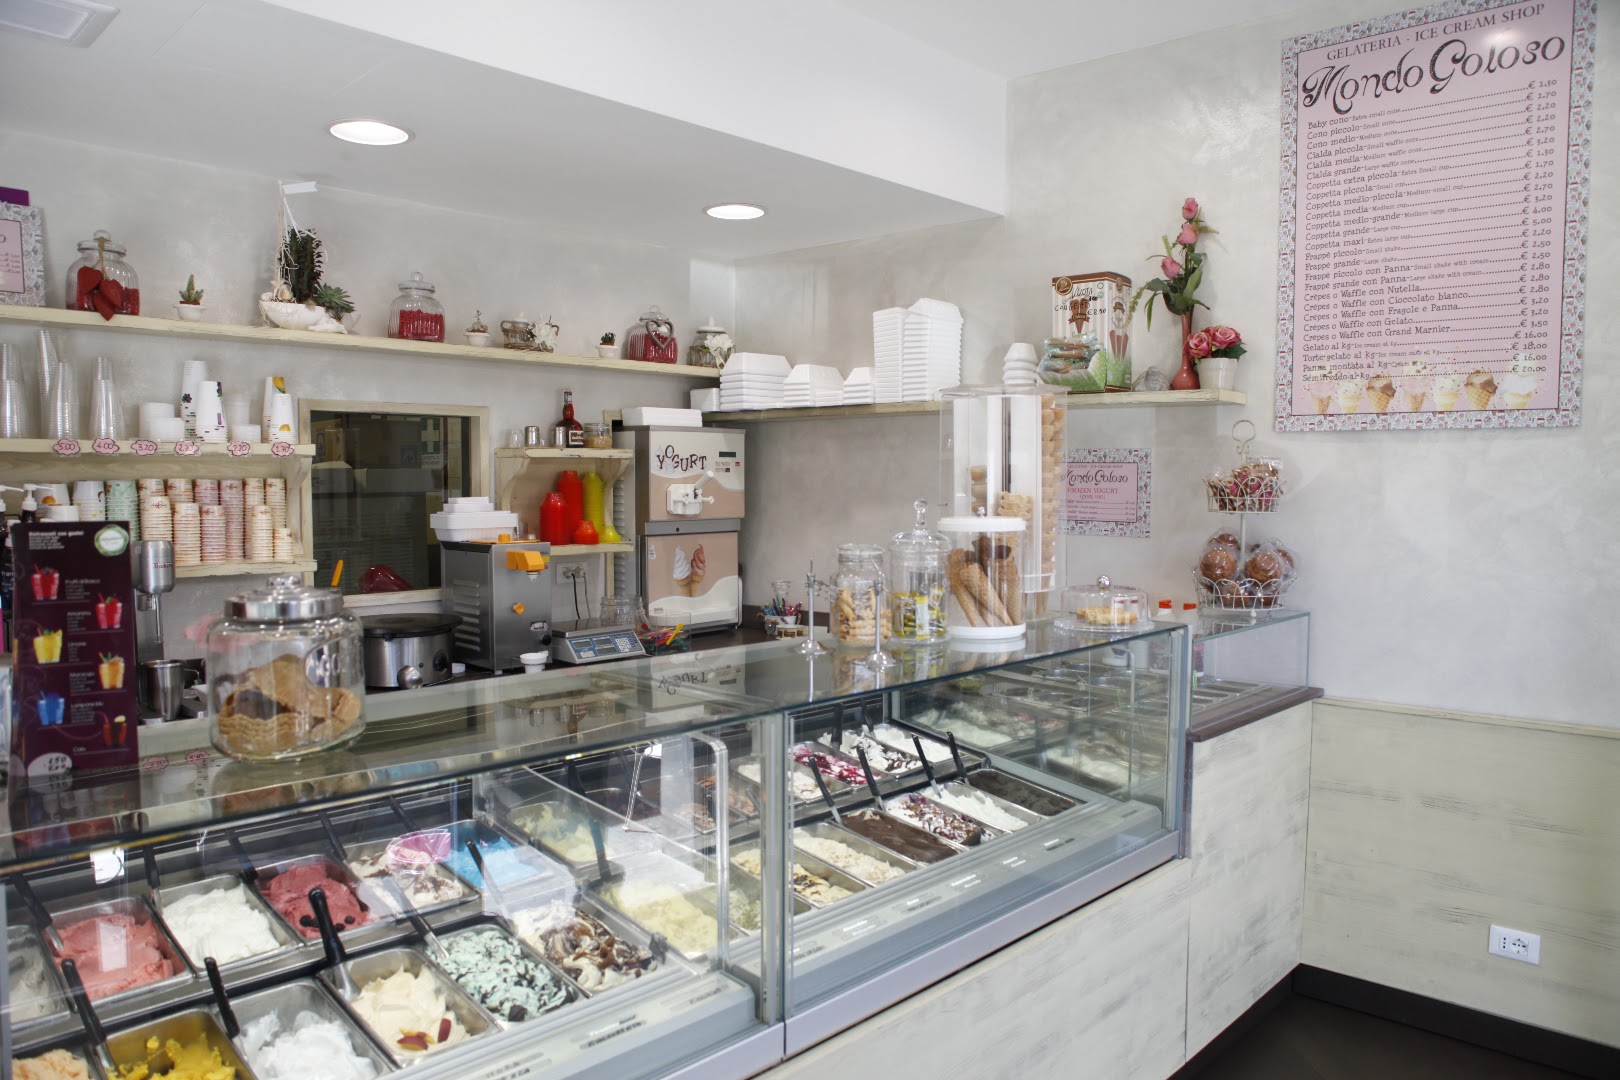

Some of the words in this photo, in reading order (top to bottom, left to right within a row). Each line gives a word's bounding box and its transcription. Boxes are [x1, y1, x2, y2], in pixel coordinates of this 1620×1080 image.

[1327, 36, 1402, 61] GELATERIA
[1415, 27, 1438, 42] ICE
[1442, 14, 1496, 37] CREAM
[1501, 2, 1545, 23] SHOP
[1302, 48, 1424, 114] Mondo
[1430, 36, 1566, 95] Goloso
[1308, 120, 1327, 129] Baby
[1306, 150, 1332, 159] Cialda
[1306, 170, 1331, 180] Cialda
[1537, 137, 1554, 145] 3.20
[1306, 160, 1331, 169] Cialda
[1306, 179, 1341, 190] Coppetta
[1306, 190, 1341, 200] Coppetta
[1306, 200, 1341, 210] Coppetta
[1306, 220, 1340, 230] Coppetta
[1535, 194, 1552, 202] 3.20
[1306, 210, 1340, 220] Coppetta
[1305, 231, 1340, 240] Coppetta
[1305, 241, 1340, 250] Coppetta
[1332, 280, 1359, 289] grande
[1531, 262, 1550, 270] 2.80
[1333, 269, 1362, 279] piccolo
[1341, 289, 1365, 297] Waffle
[1387, 284, 1419, 294] Nutella
[1388, 294, 1434, 304] Cioccolato
[1341, 309, 1366, 317] Waffle
[1388, 306, 1418, 315] Fragole
[1384, 327, 1411, 336] Grand
[1415, 325, 1450, 334] Marnier
[1327, 352, 1351, 361] gelato
[1523, 341, 1547, 349] 18.00
[656, 445, 706, 471] YOGURT
[1094, 470, 1128, 486] Goloso
